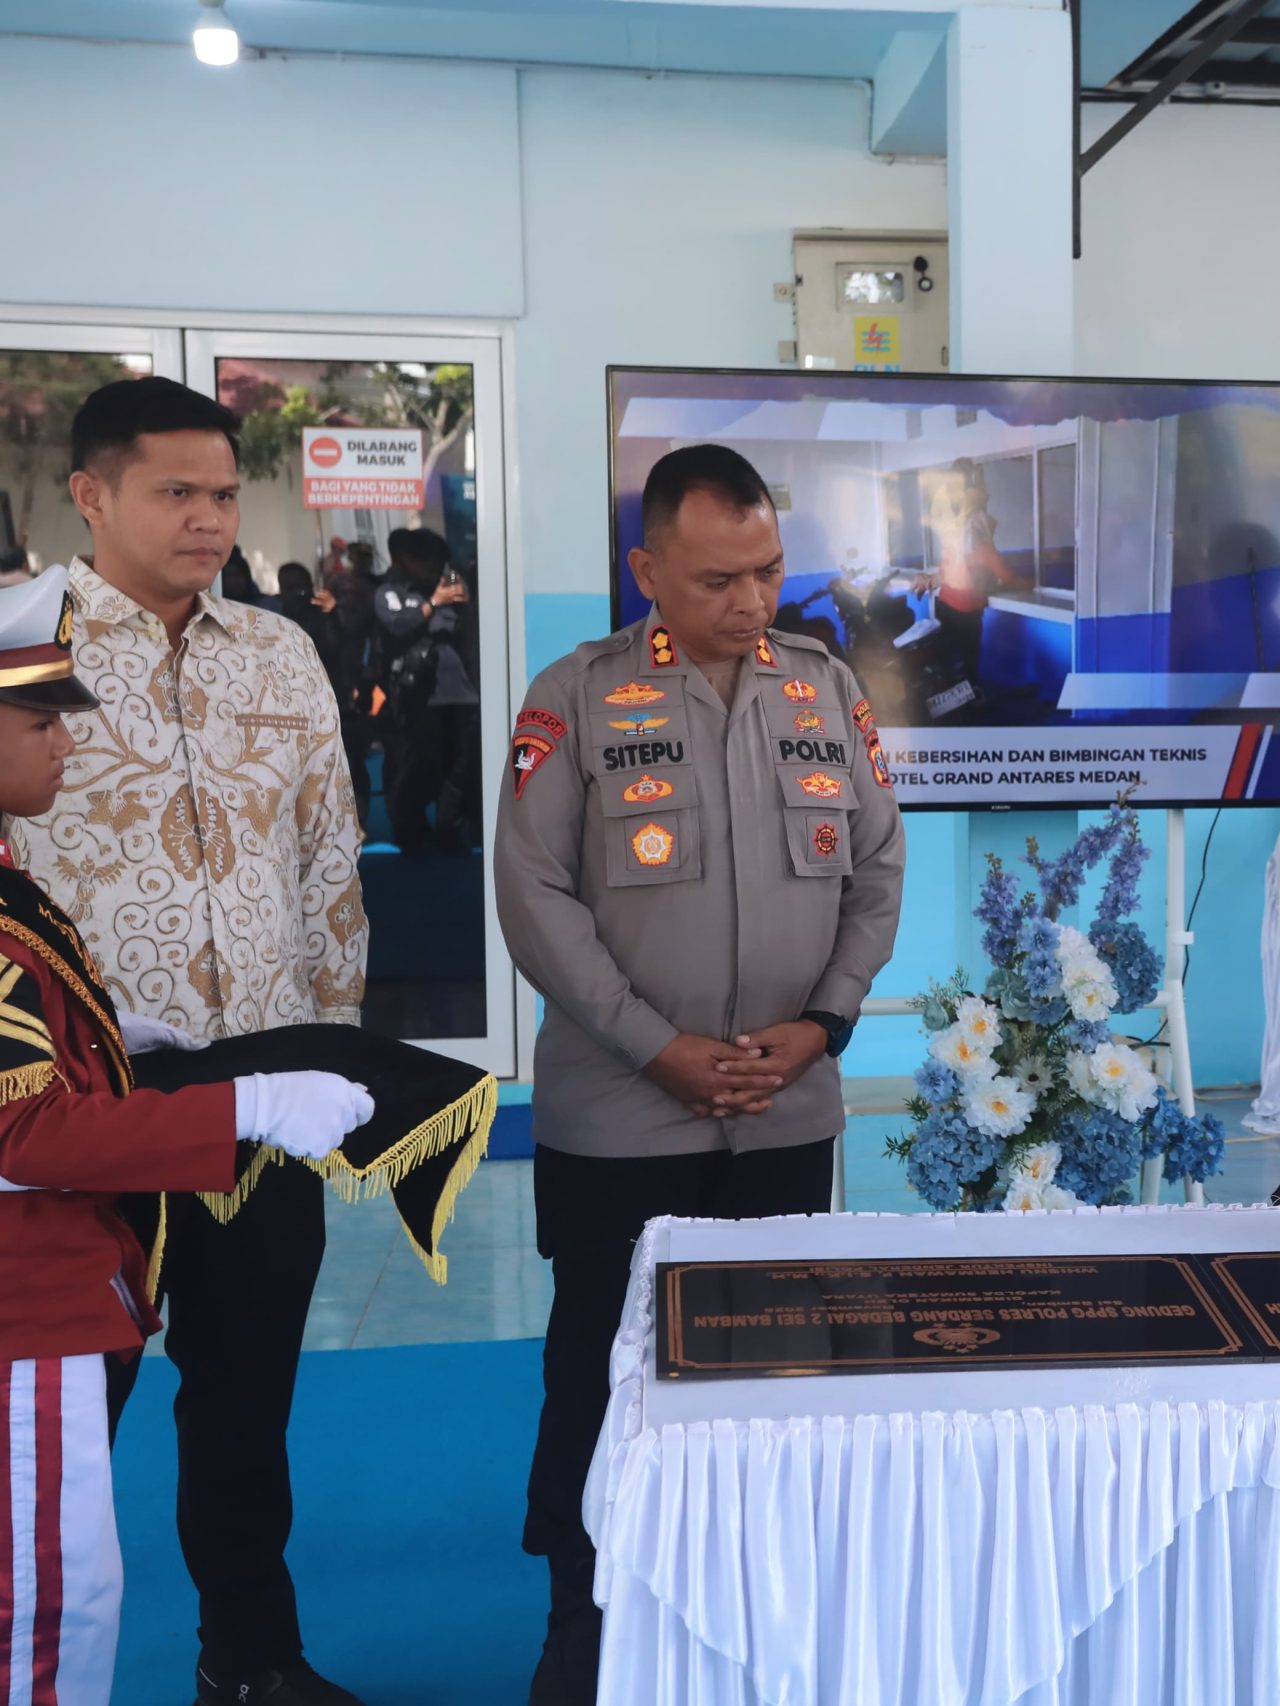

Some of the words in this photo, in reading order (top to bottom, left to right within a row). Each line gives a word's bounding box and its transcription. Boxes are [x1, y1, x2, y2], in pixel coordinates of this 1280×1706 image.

[347, 440, 417, 453] DILARANG
[357, 455, 406, 466] MASUK
[311, 480, 340, 491] BAGI
[343, 481, 376, 492] YANG
[379, 482, 416, 493] TIDAK
[308, 493, 420, 506] BERKEPENTINGAN
[603, 740, 684, 771] SITEPU
[779, 739, 846, 765] POLRI
[895, 750, 1003, 763] KEBERSIHAN
[1008, 750, 1044, 762] DAN
[1049, 749, 1145, 762] BIMBINGAN
[1150, 749, 1207, 761] TEKNIS
[932, 772, 993, 785] GRAND
[998, 771, 1075, 785] ANTARES
[1079, 770, 1140, 783] MEDAN
[828, 1311, 905, 1324] BEDAGAI
[911, 1309, 995, 1322] SERDANG
[999, 1308, 1068, 1320] POLRES
[1071, 1307, 1118, 1318] SPPG
[1122, 1305, 1195, 1317] GEDUNG
[694, 1315, 771, 1327] BAMBAN
[778, 1314, 805, 1326] SEI
